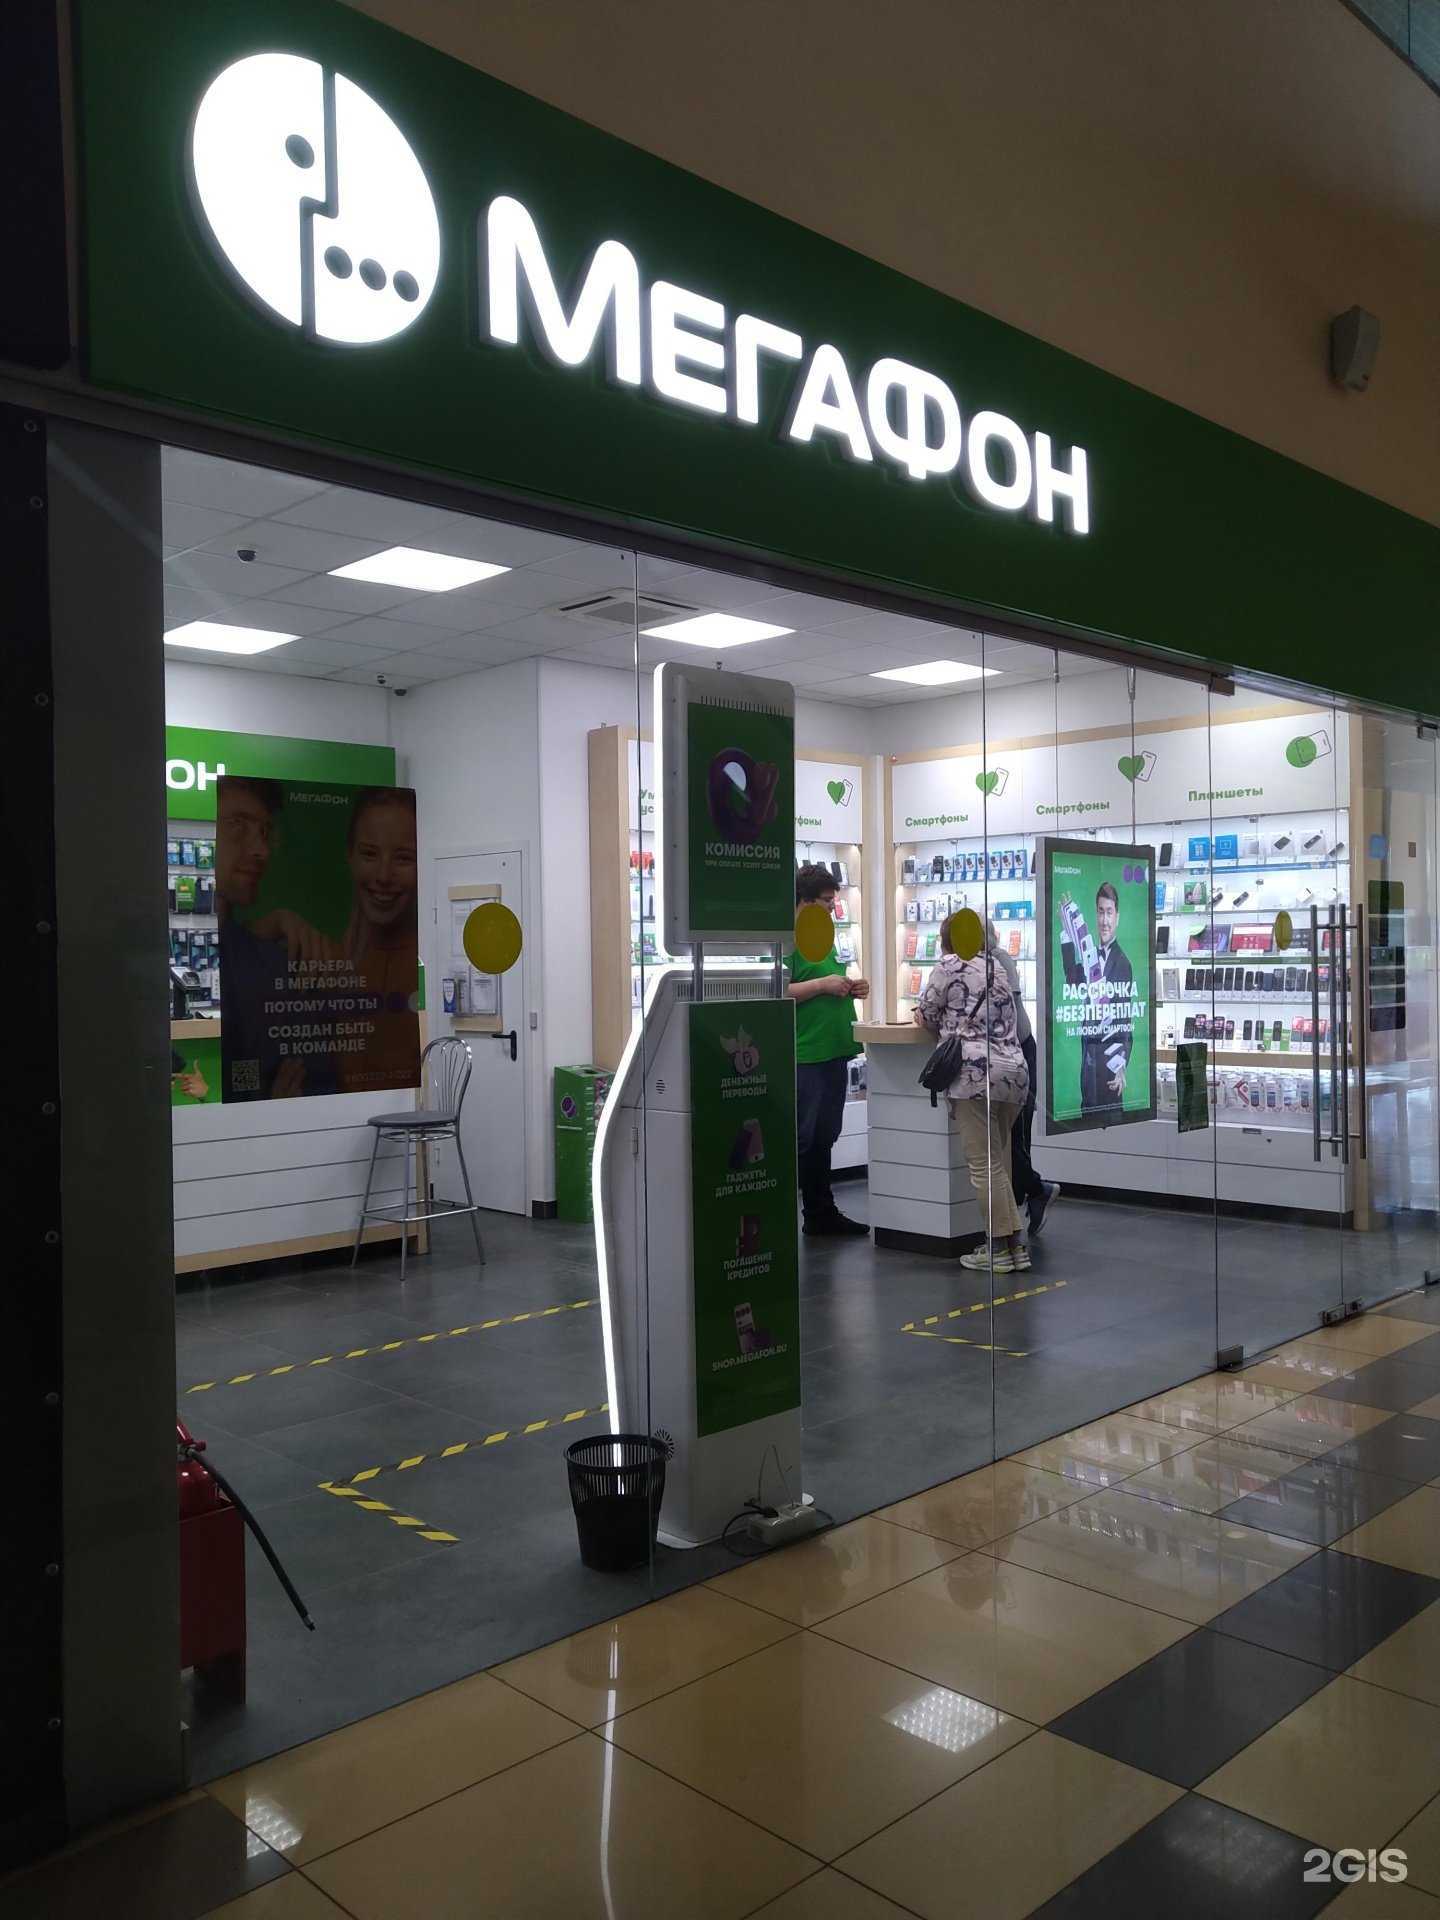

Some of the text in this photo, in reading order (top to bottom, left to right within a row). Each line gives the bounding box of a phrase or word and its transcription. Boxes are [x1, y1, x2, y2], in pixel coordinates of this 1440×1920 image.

[488, 195, 1090, 535] МЕГАФОН
[289, 791, 350, 806] МЕГАФОН
[1188, 787, 1264, 802] Планшеты
[1036, 801, 1110, 817] Смартфоны
[905, 813, 969, 828] Смартфоны
[704, 842, 781, 860] КОМИССИЯ
[288, 960, 354, 973] КАРЬЕРА
[274, 976, 367, 990] В МЕГАФОНЕ
[1062, 981, 1138, 1001] РАССРОЧКА
[264, 998, 377, 1014] ПОТОМУ ЧТО ТЫ
[1056, 1001, 1146, 1023] #БЕЗПЕРЕПЛАТ
[268, 1021, 375, 1039] СОЗДАН БЫТЬ
[279, 1039, 367, 1055] В КОМАНДЕ
[726, 1168, 767, 1183] ГАДЖЕТЫ
[735, 1178, 777, 1194] КАЖДОГО
